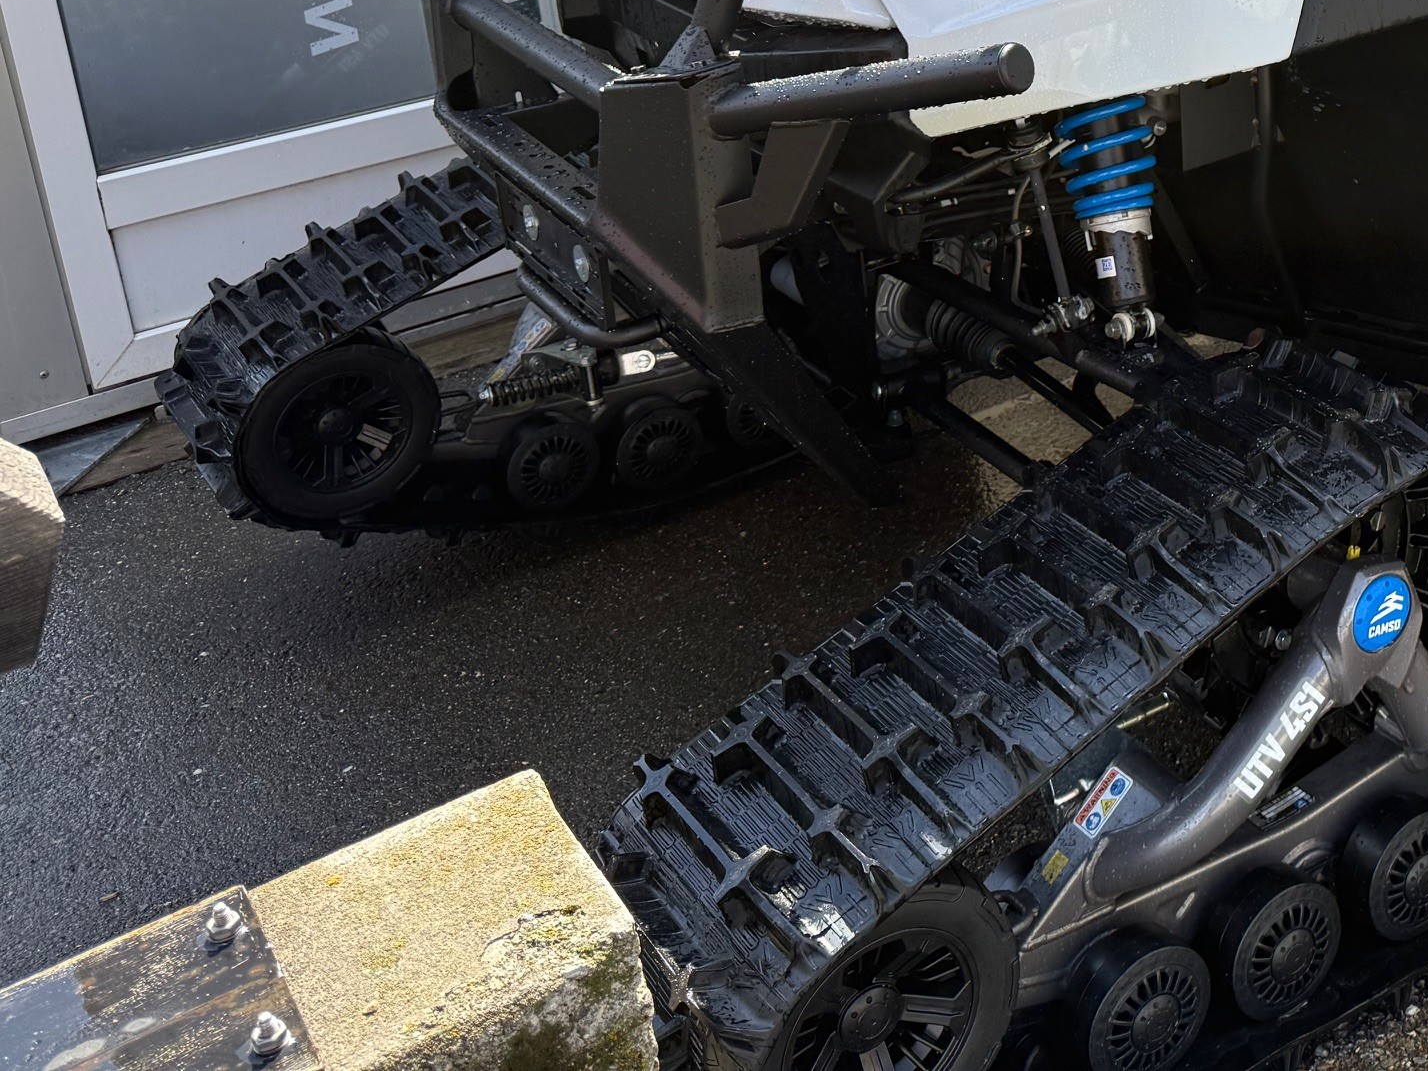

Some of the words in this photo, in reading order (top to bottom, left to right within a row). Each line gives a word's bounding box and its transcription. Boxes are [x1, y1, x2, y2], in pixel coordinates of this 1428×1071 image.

[1367, 618, 1402, 639] CAMSO
[1233, 732, 1286, 799] UTV
[1279, 681, 1326, 741] 4S1
